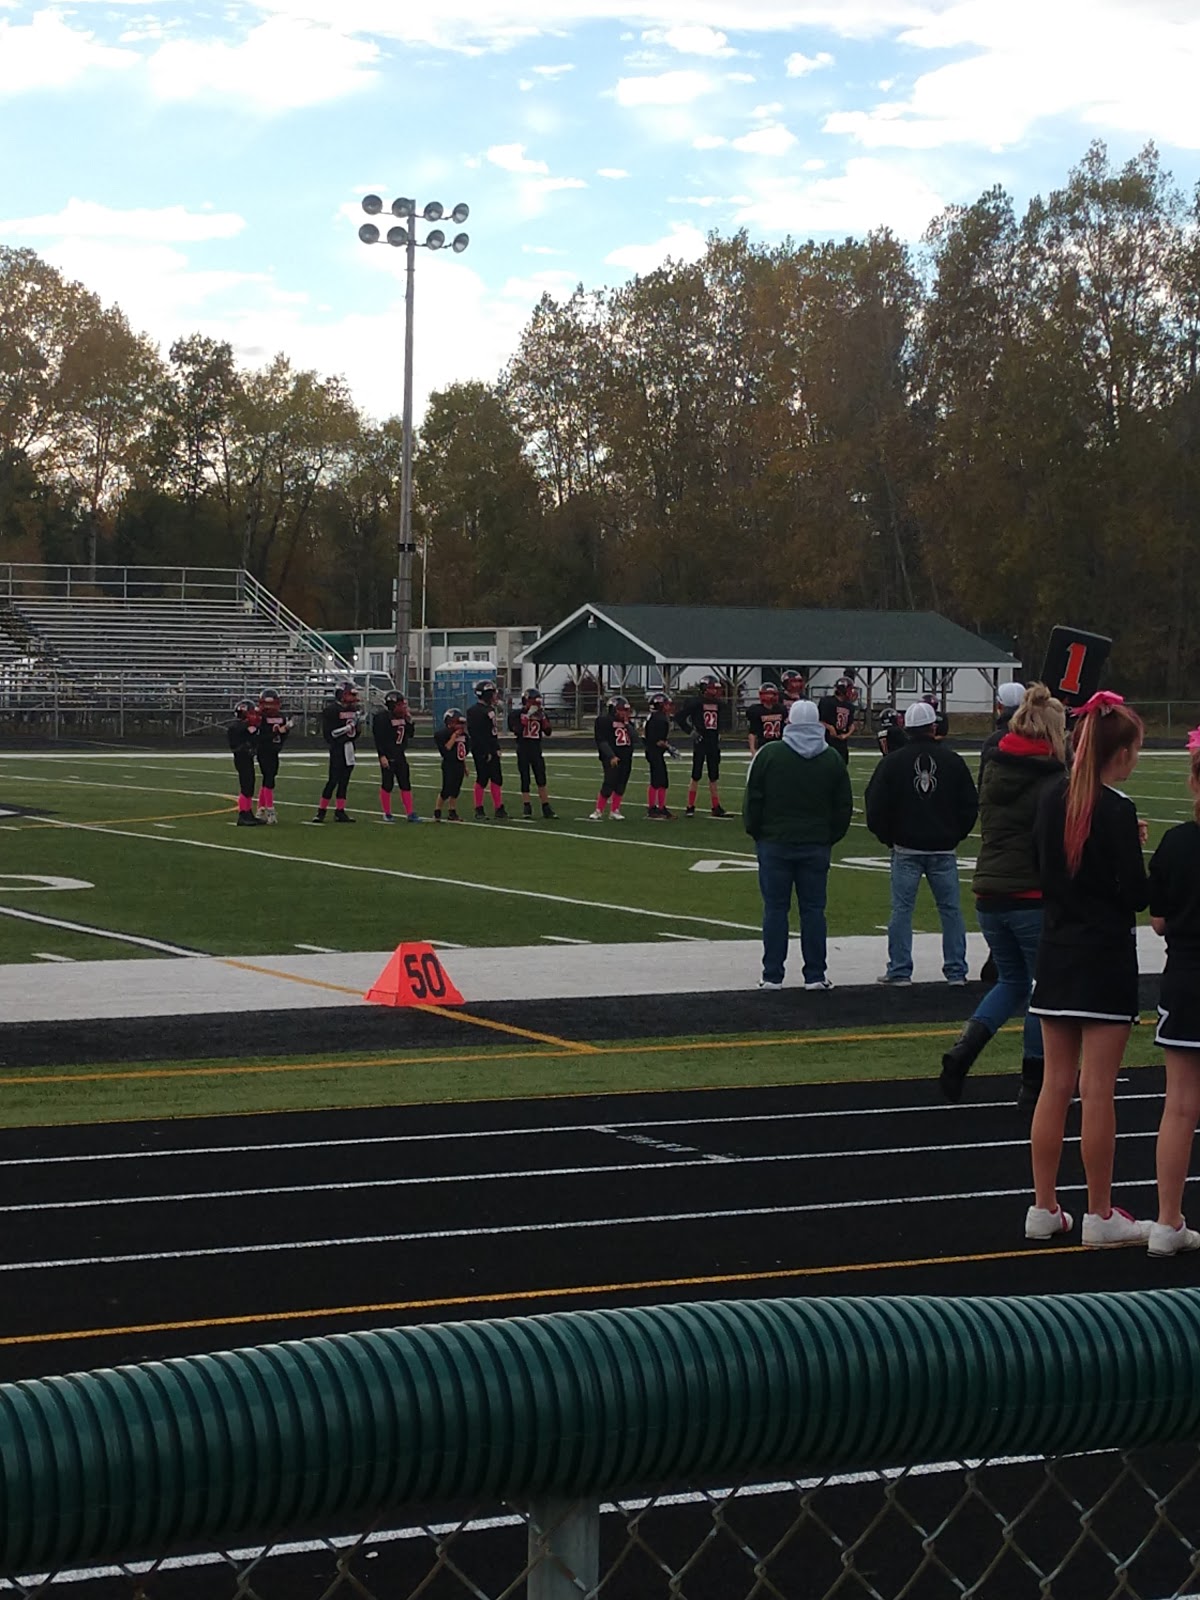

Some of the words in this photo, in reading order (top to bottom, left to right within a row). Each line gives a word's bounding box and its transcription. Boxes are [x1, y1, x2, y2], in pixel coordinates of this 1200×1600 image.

[1059, 642, 1087, 695] 1
[522, 720, 541, 739] 12
[403, 953, 447, 999] 50
